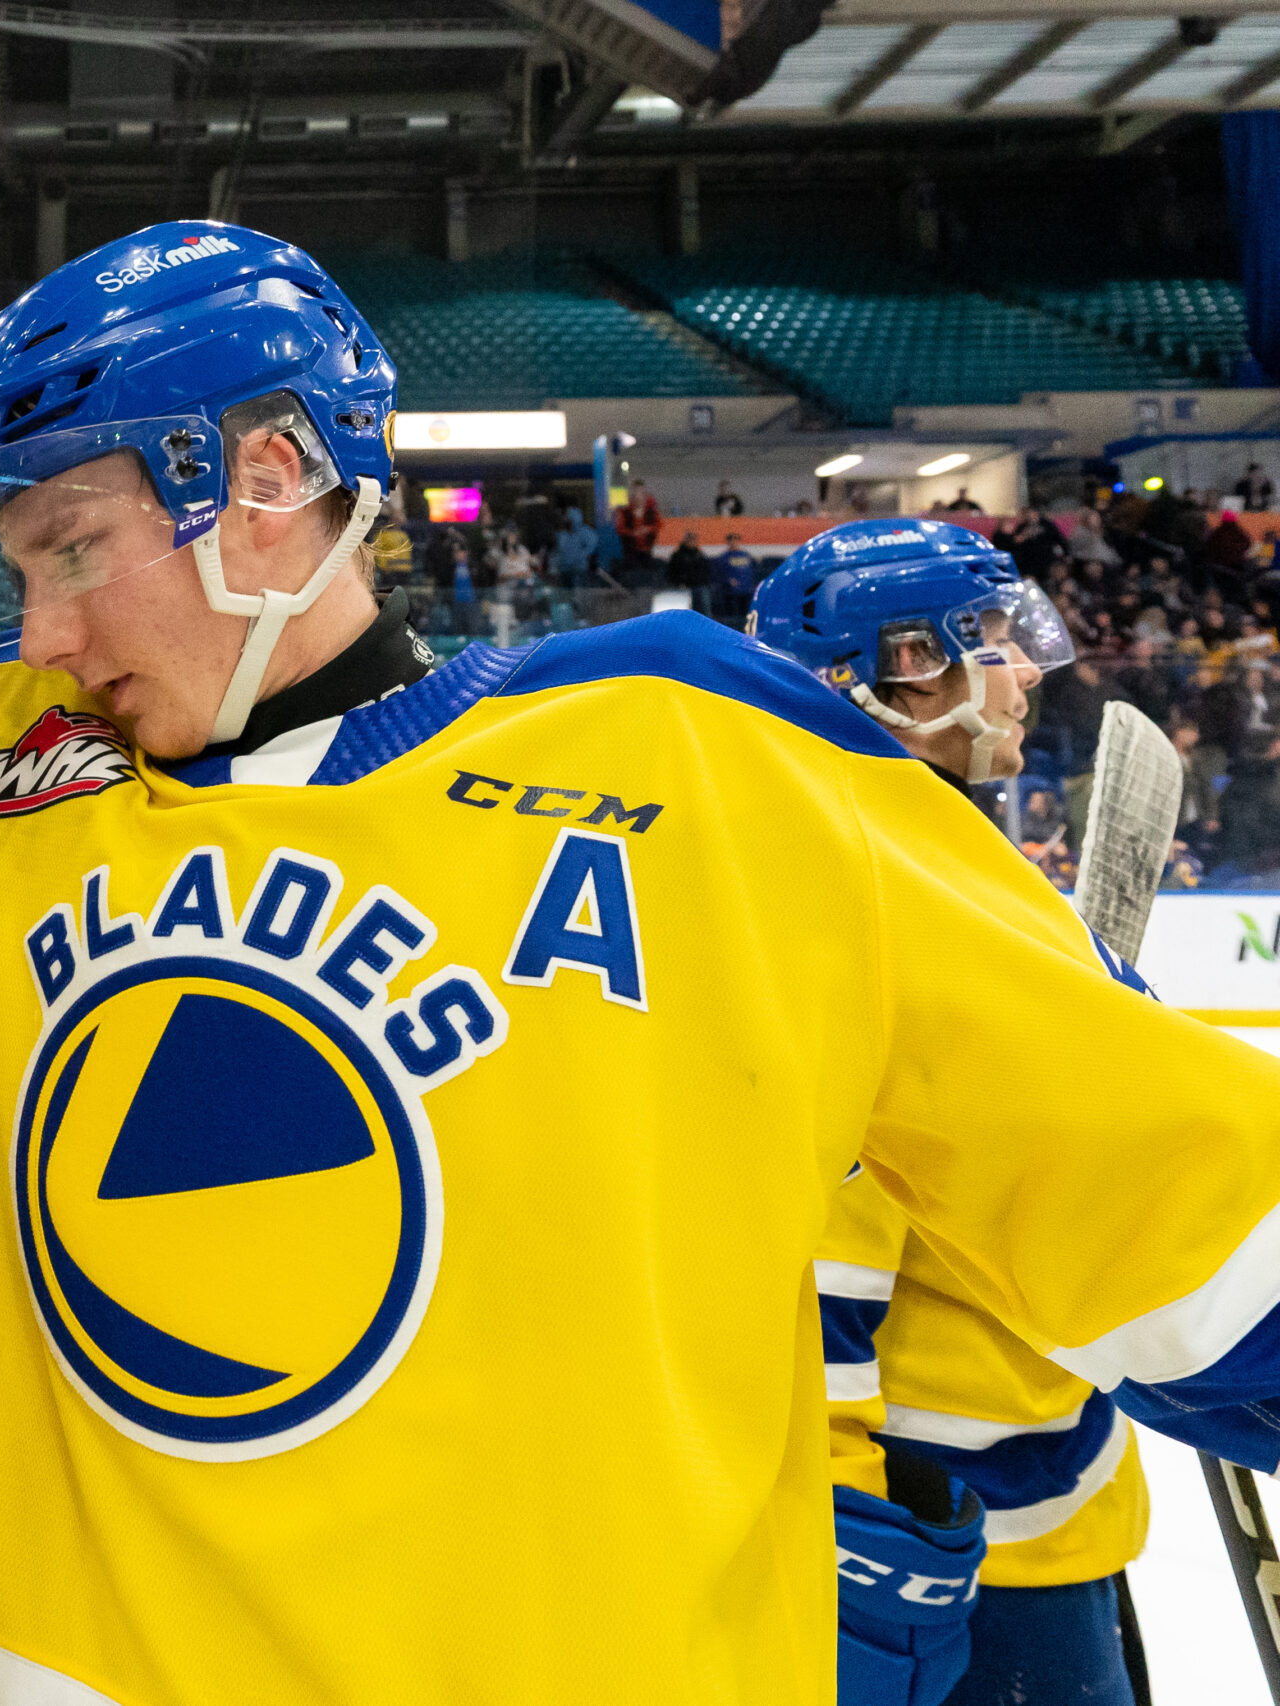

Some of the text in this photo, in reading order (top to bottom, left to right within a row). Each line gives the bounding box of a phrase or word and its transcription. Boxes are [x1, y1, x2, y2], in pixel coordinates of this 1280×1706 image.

[178, 509, 217, 531] CCM
[446, 769, 664, 834] CCM
[27, 850, 498, 1079] BLADES
[505, 829, 646, 1008] A
